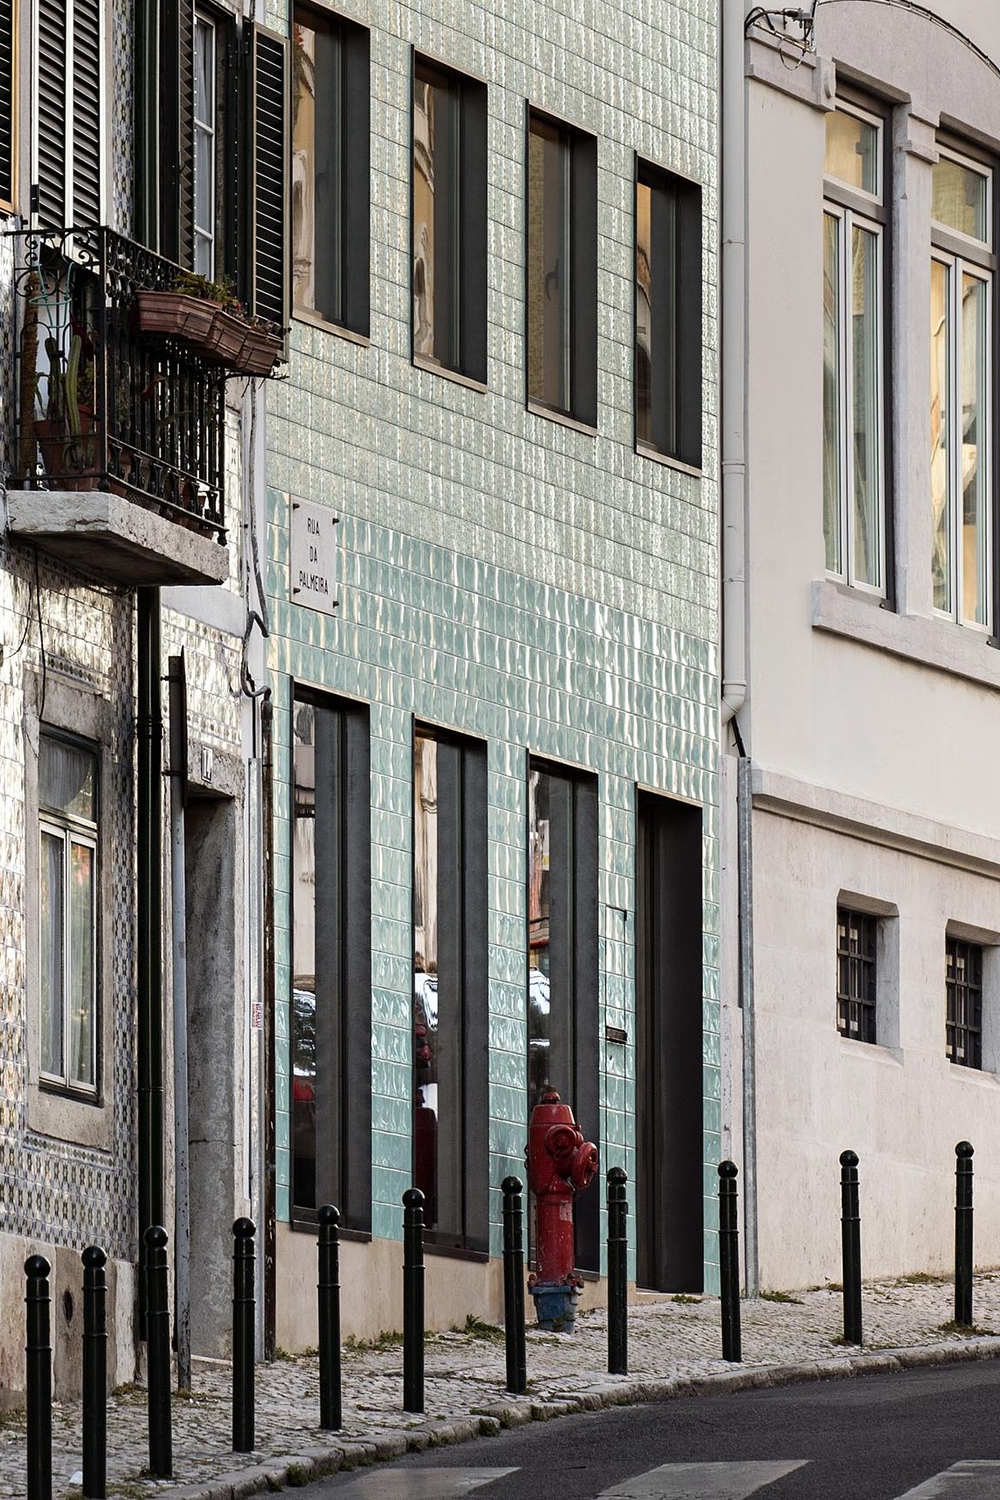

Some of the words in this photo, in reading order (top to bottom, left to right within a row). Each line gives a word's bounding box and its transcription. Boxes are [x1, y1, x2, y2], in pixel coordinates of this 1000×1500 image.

[307, 517, 320, 536] RUA
[309, 546, 318, 563] DA
[299, 570, 329, 595] PALMEIRA
